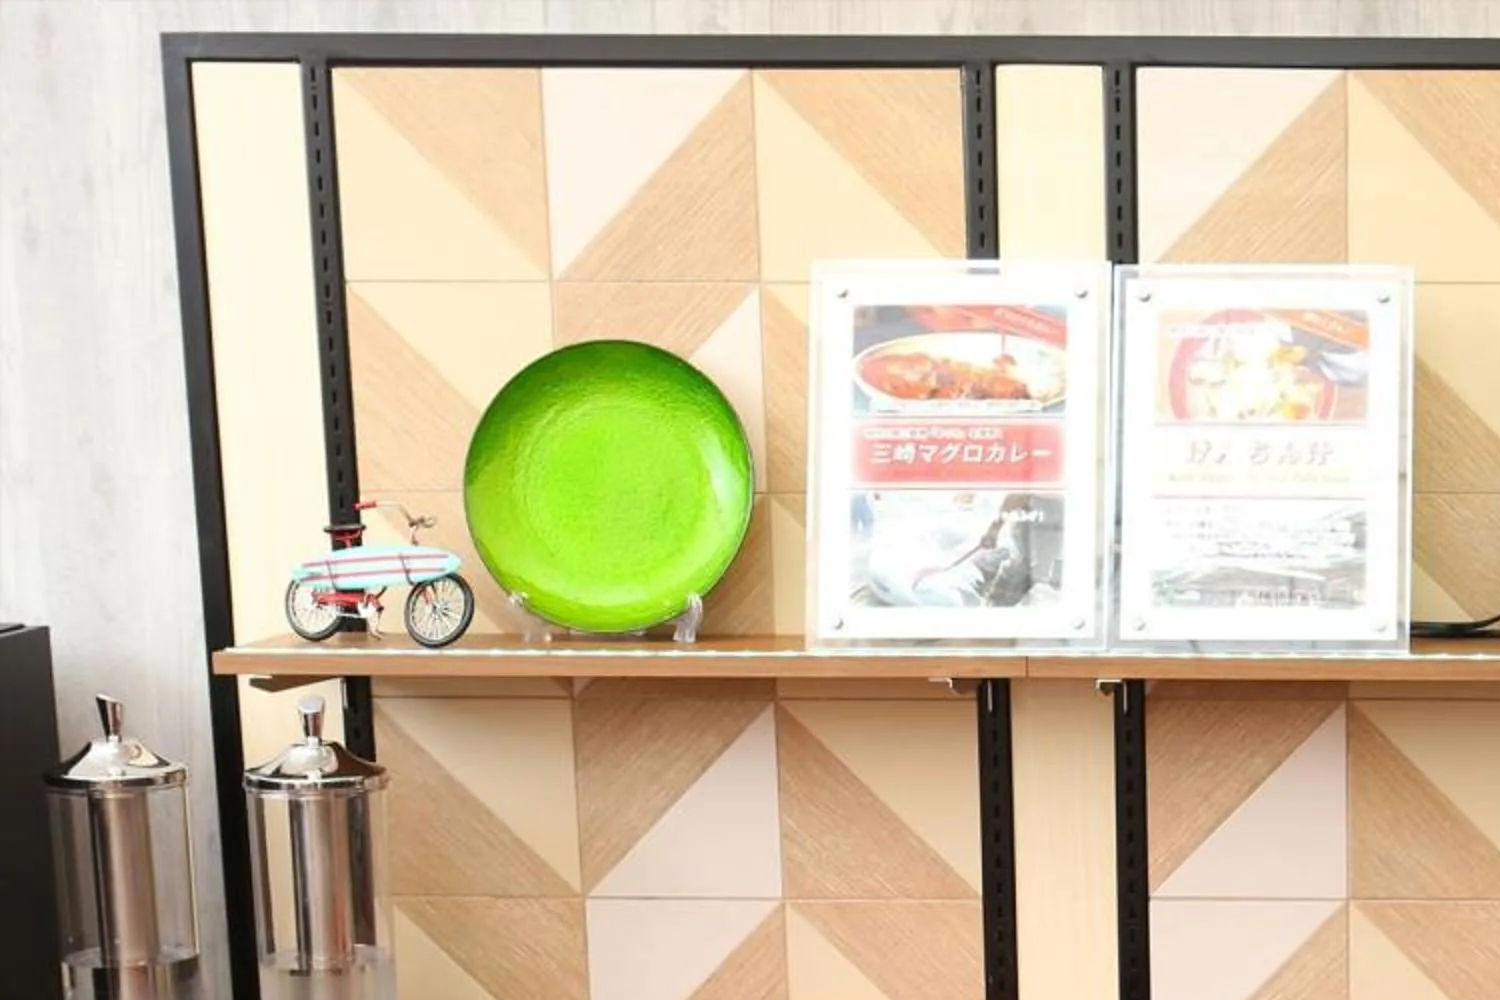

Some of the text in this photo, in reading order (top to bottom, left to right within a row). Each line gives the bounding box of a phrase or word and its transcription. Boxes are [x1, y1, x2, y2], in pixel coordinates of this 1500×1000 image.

[869, 441, 1053, 464] 三崎マグロカレー
